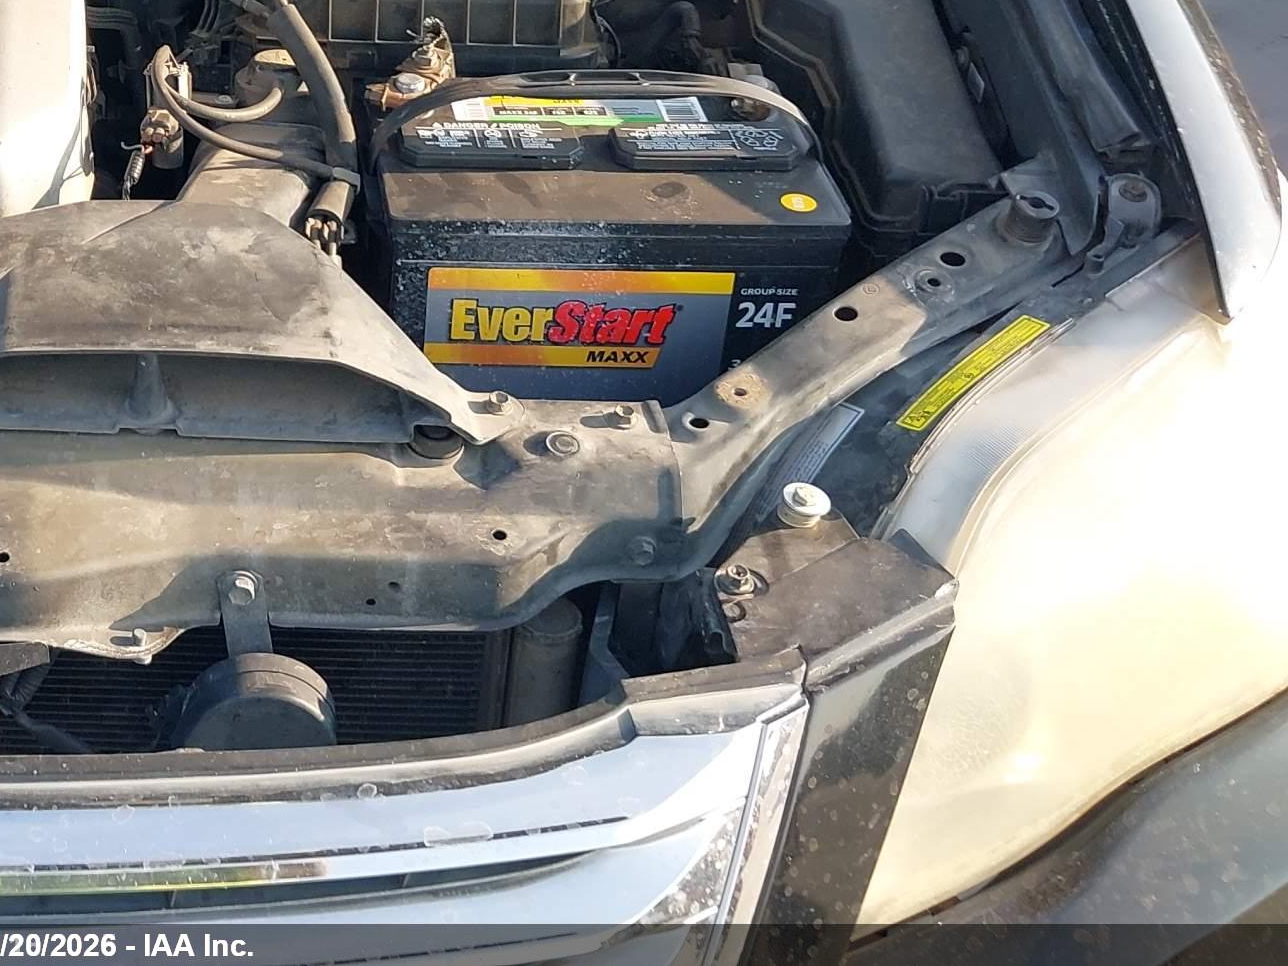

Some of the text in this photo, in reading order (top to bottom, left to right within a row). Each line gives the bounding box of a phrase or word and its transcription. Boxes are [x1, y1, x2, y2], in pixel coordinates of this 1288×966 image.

[740, 288, 799, 296] GROUP SIZE
[449, 298, 677, 345] EverStart
[735, 301, 797, 328] 24F
[586, 350, 650, 364] MAXX
